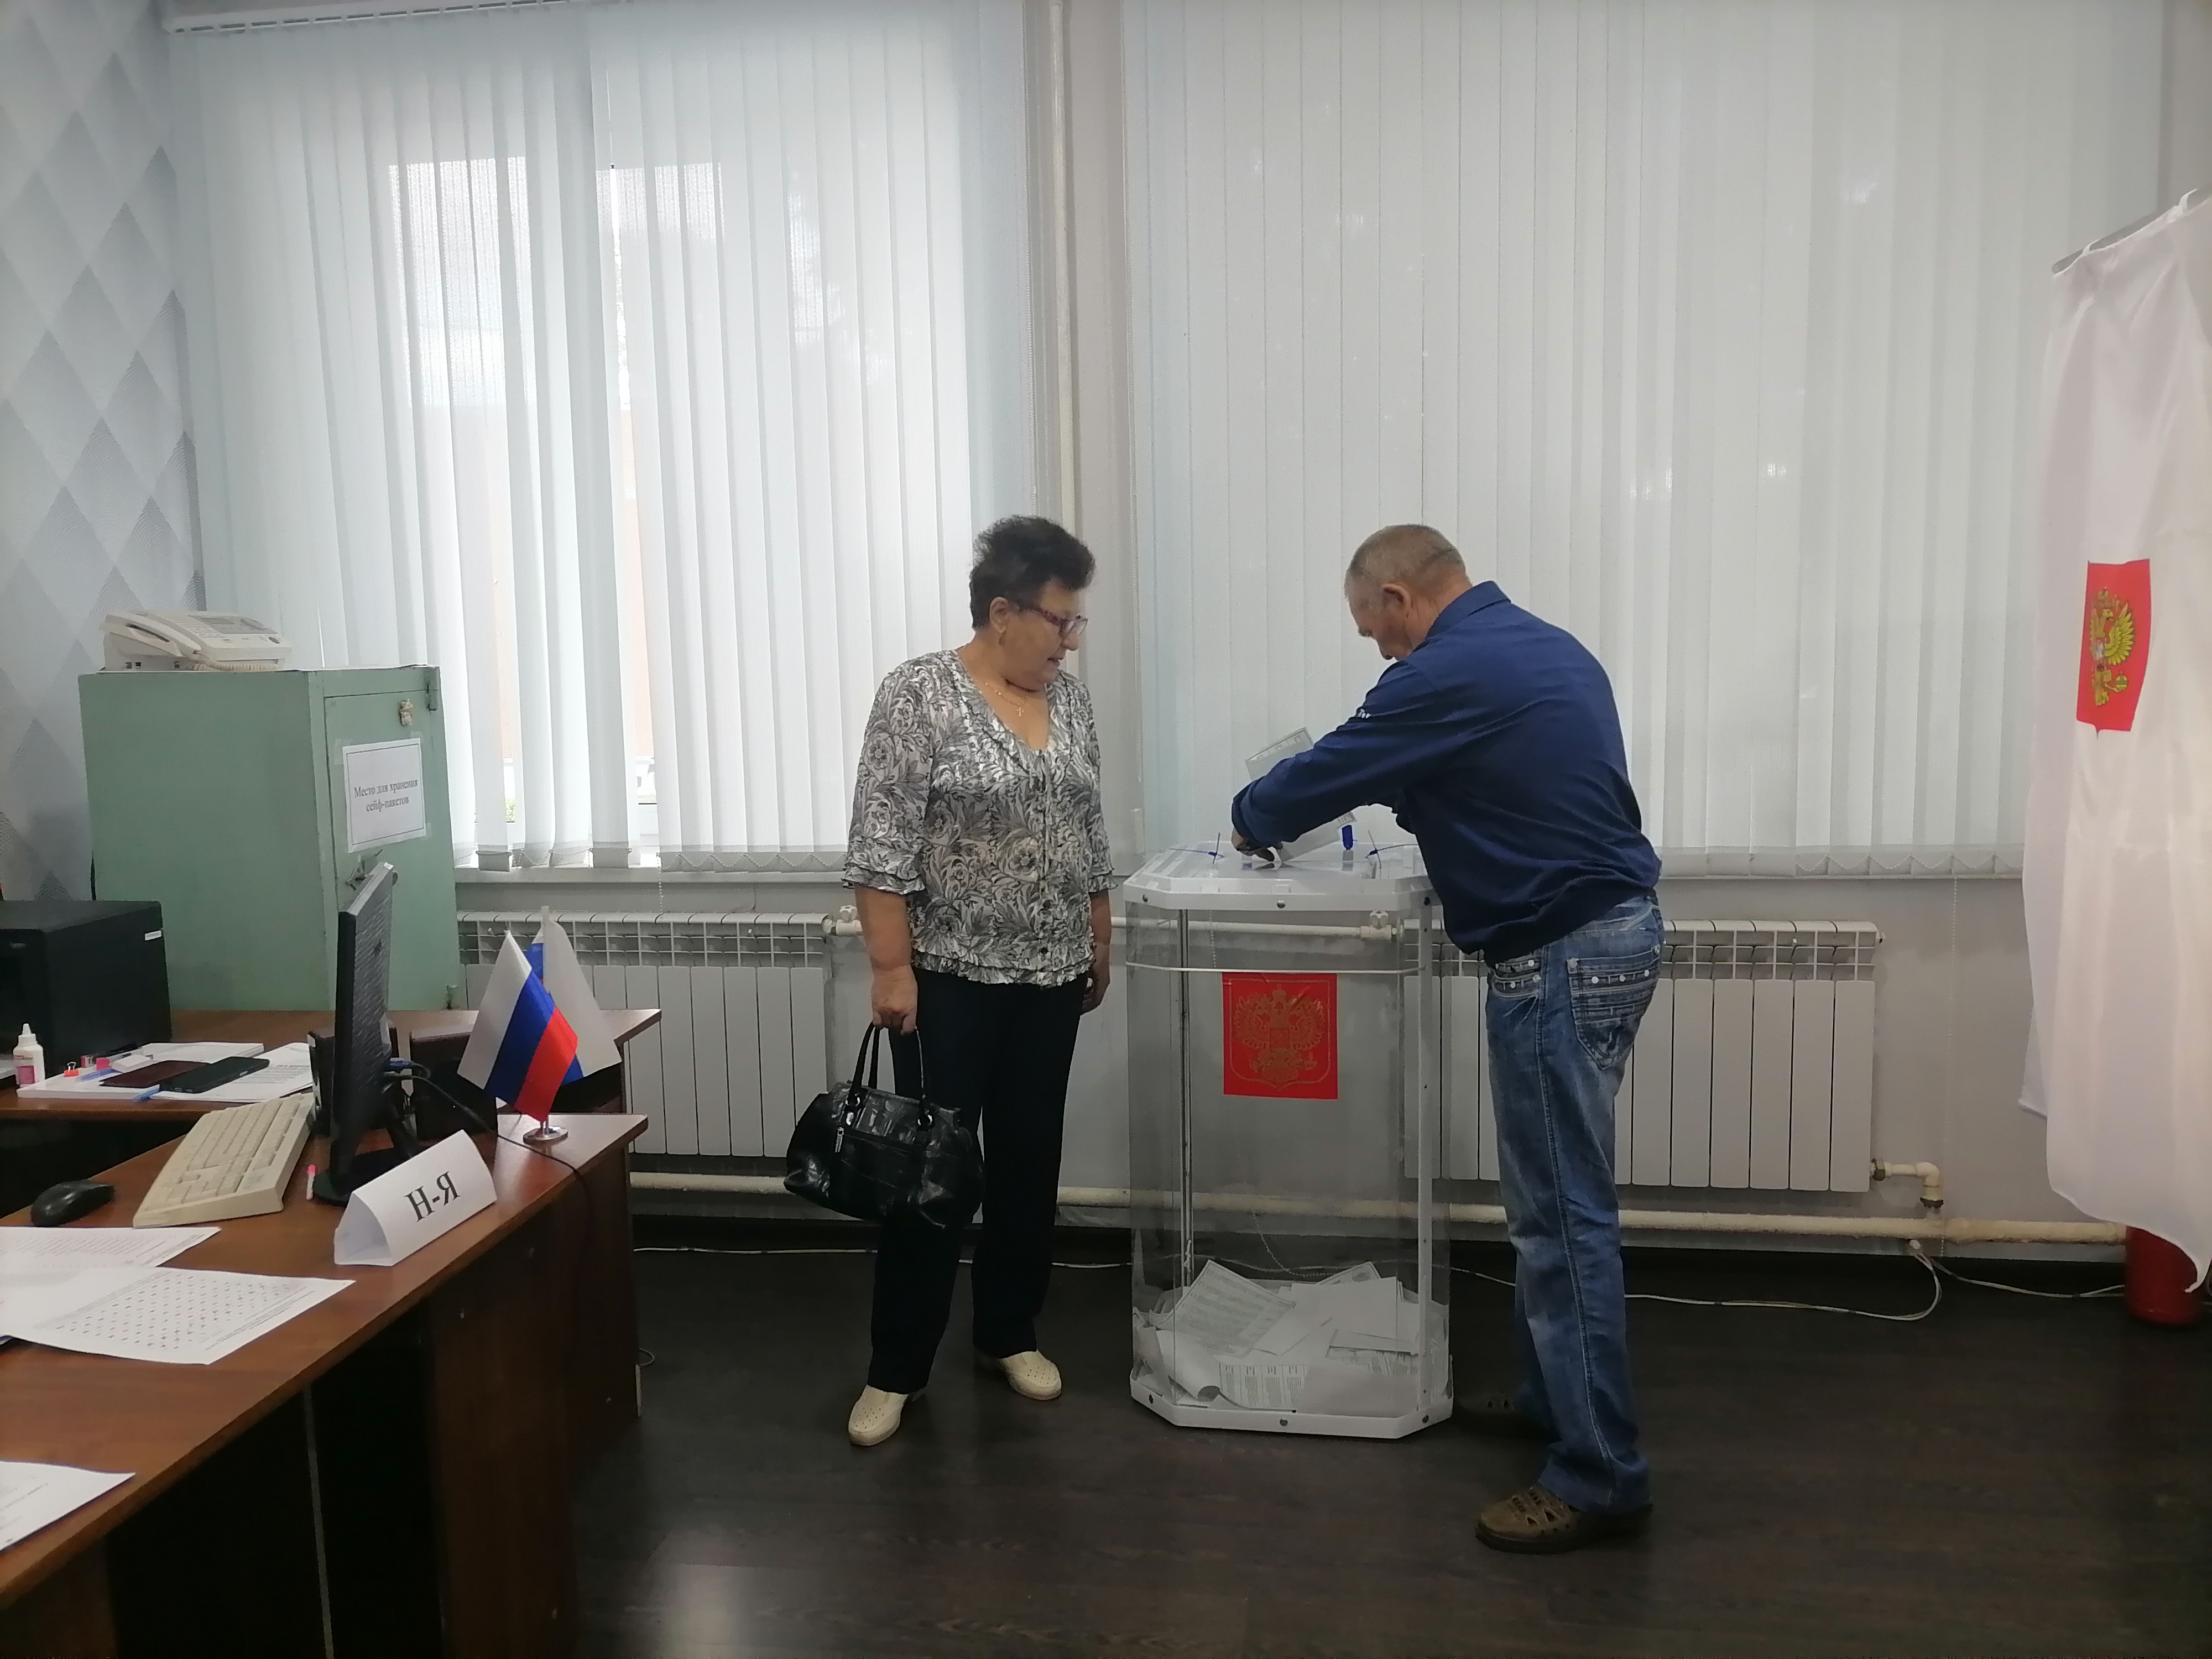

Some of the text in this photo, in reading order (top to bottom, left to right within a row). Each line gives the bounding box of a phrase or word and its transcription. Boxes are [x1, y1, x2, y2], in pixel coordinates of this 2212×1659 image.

[354, 780, 418, 797] Место для хранения
[366, 797, 409, 812] сейф-пакетов
[404, 1171, 461, 1223] Н-Я
